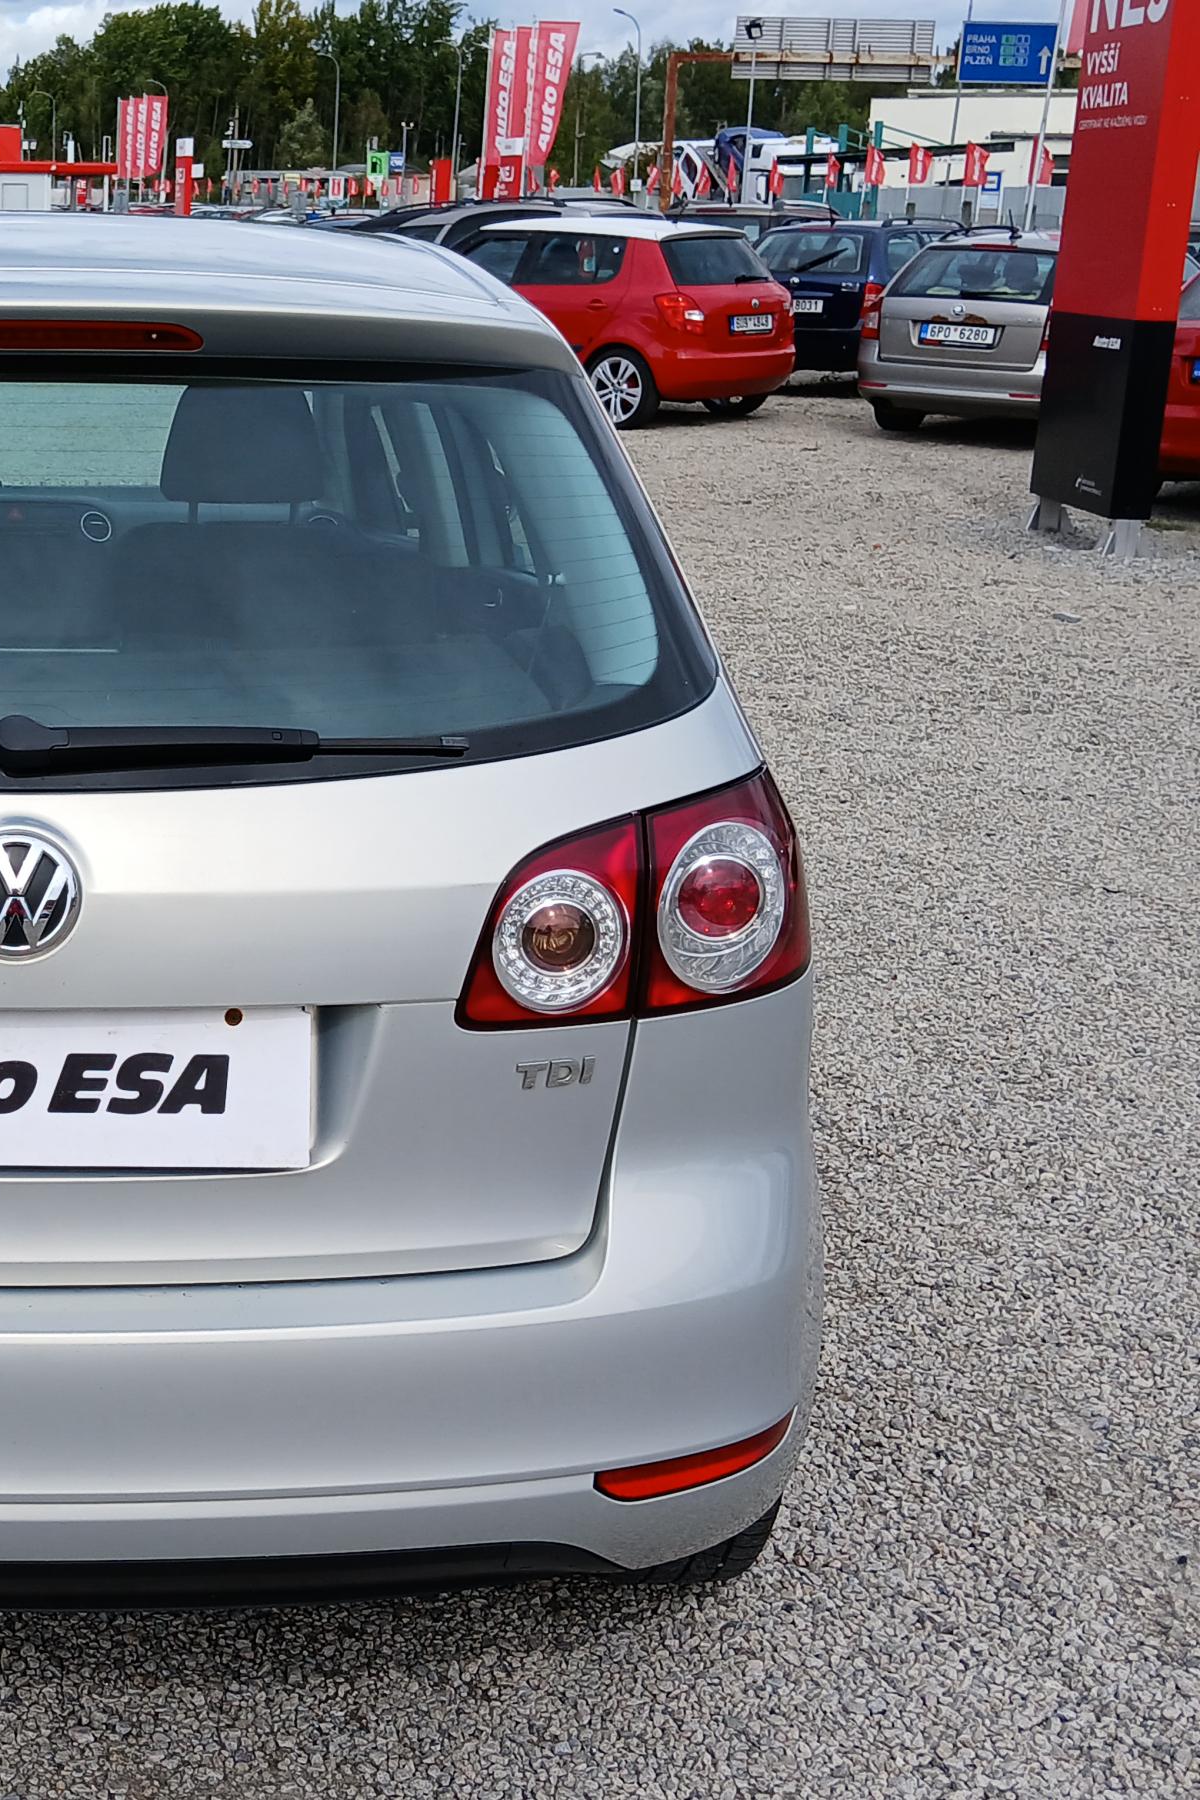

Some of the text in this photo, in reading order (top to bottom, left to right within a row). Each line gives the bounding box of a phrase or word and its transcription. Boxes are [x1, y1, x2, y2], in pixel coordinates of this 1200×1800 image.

[965, 44, 991, 54] BRNO
[966, 33, 997, 44] PRAHA
[1086, 41, 1121, 76] VYŠŠÍ
[538, 32, 567, 152] Auto ESA
[1080, 81, 1129, 110] KVALITA
[151, 101, 162, 131] ESA
[929, 325, 989, 342] 6P0 6280
[47, 1052, 230, 1114] ESA
[515, 1055, 597, 1090] TDI
